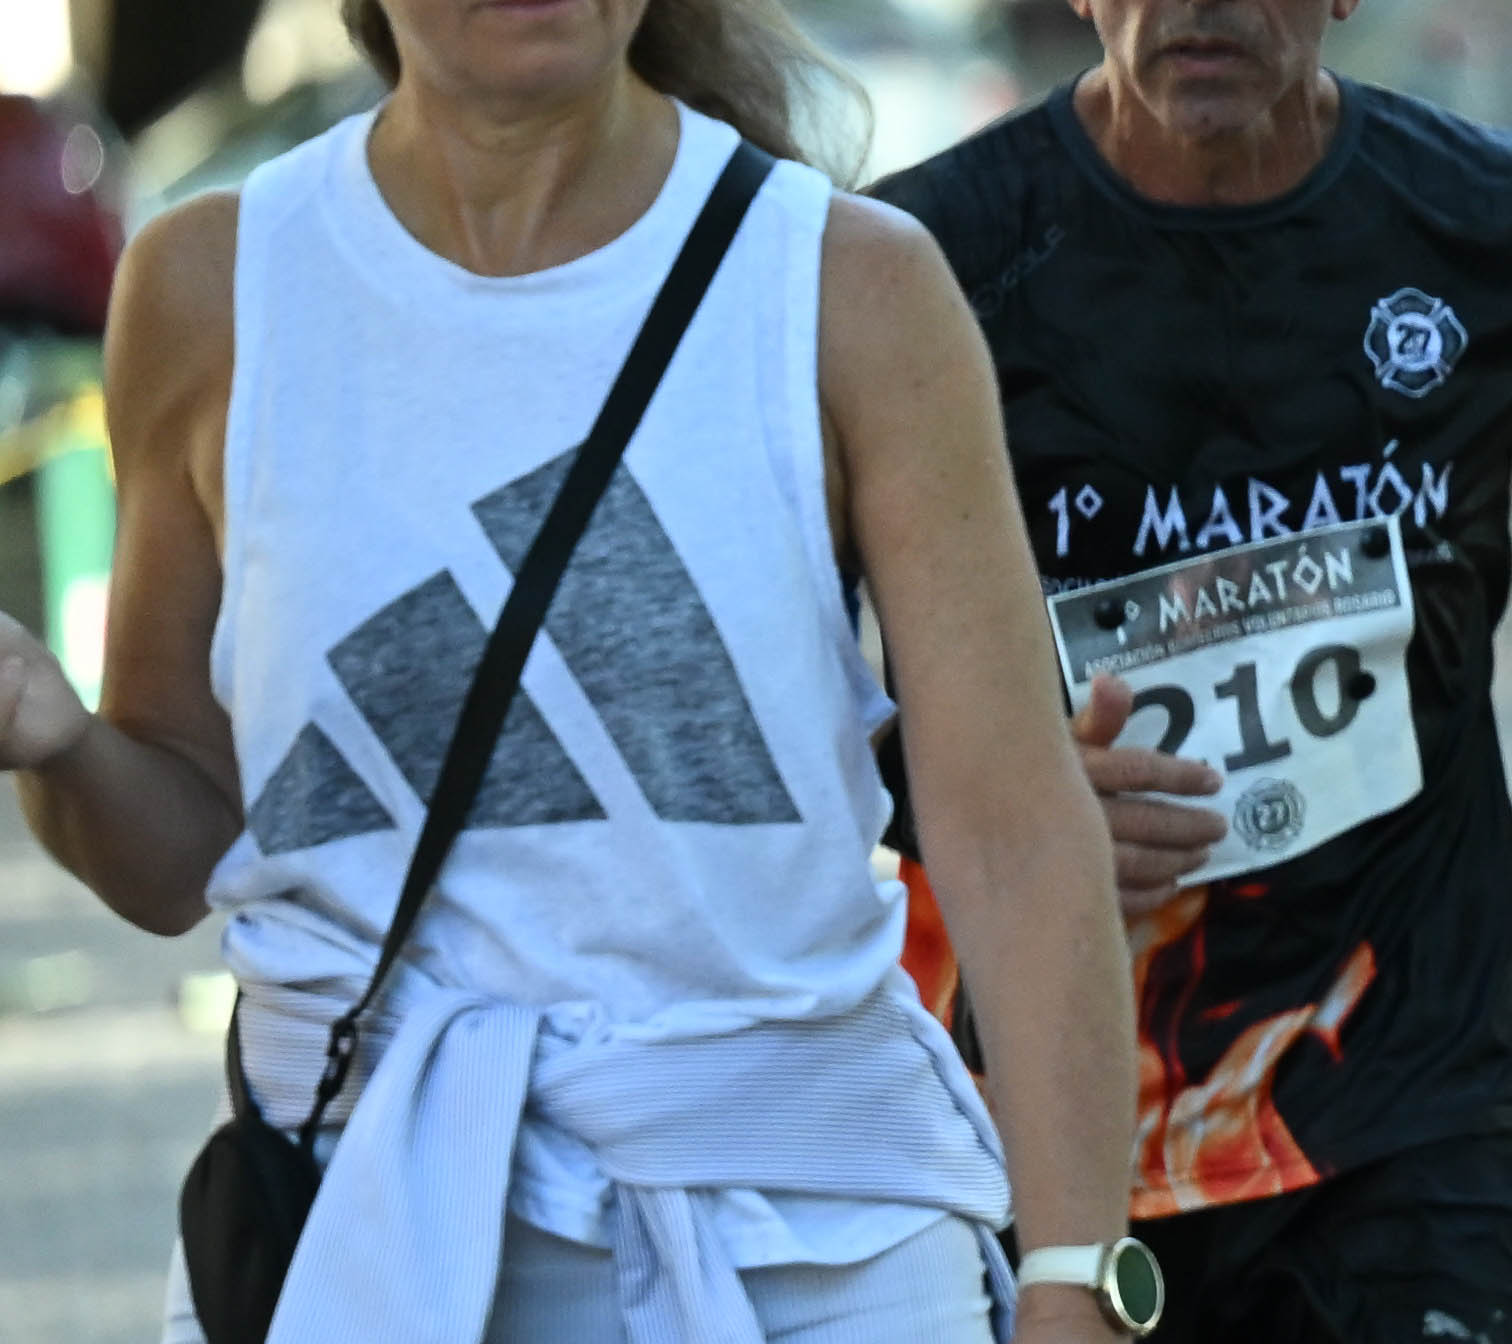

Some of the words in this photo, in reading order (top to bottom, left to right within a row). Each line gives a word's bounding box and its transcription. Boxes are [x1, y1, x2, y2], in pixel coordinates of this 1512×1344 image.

[1132, 439, 1454, 556] MARATÓN
[1158, 542, 1354, 633] MARATÓN
[1128, 644, 1363, 774] 210
